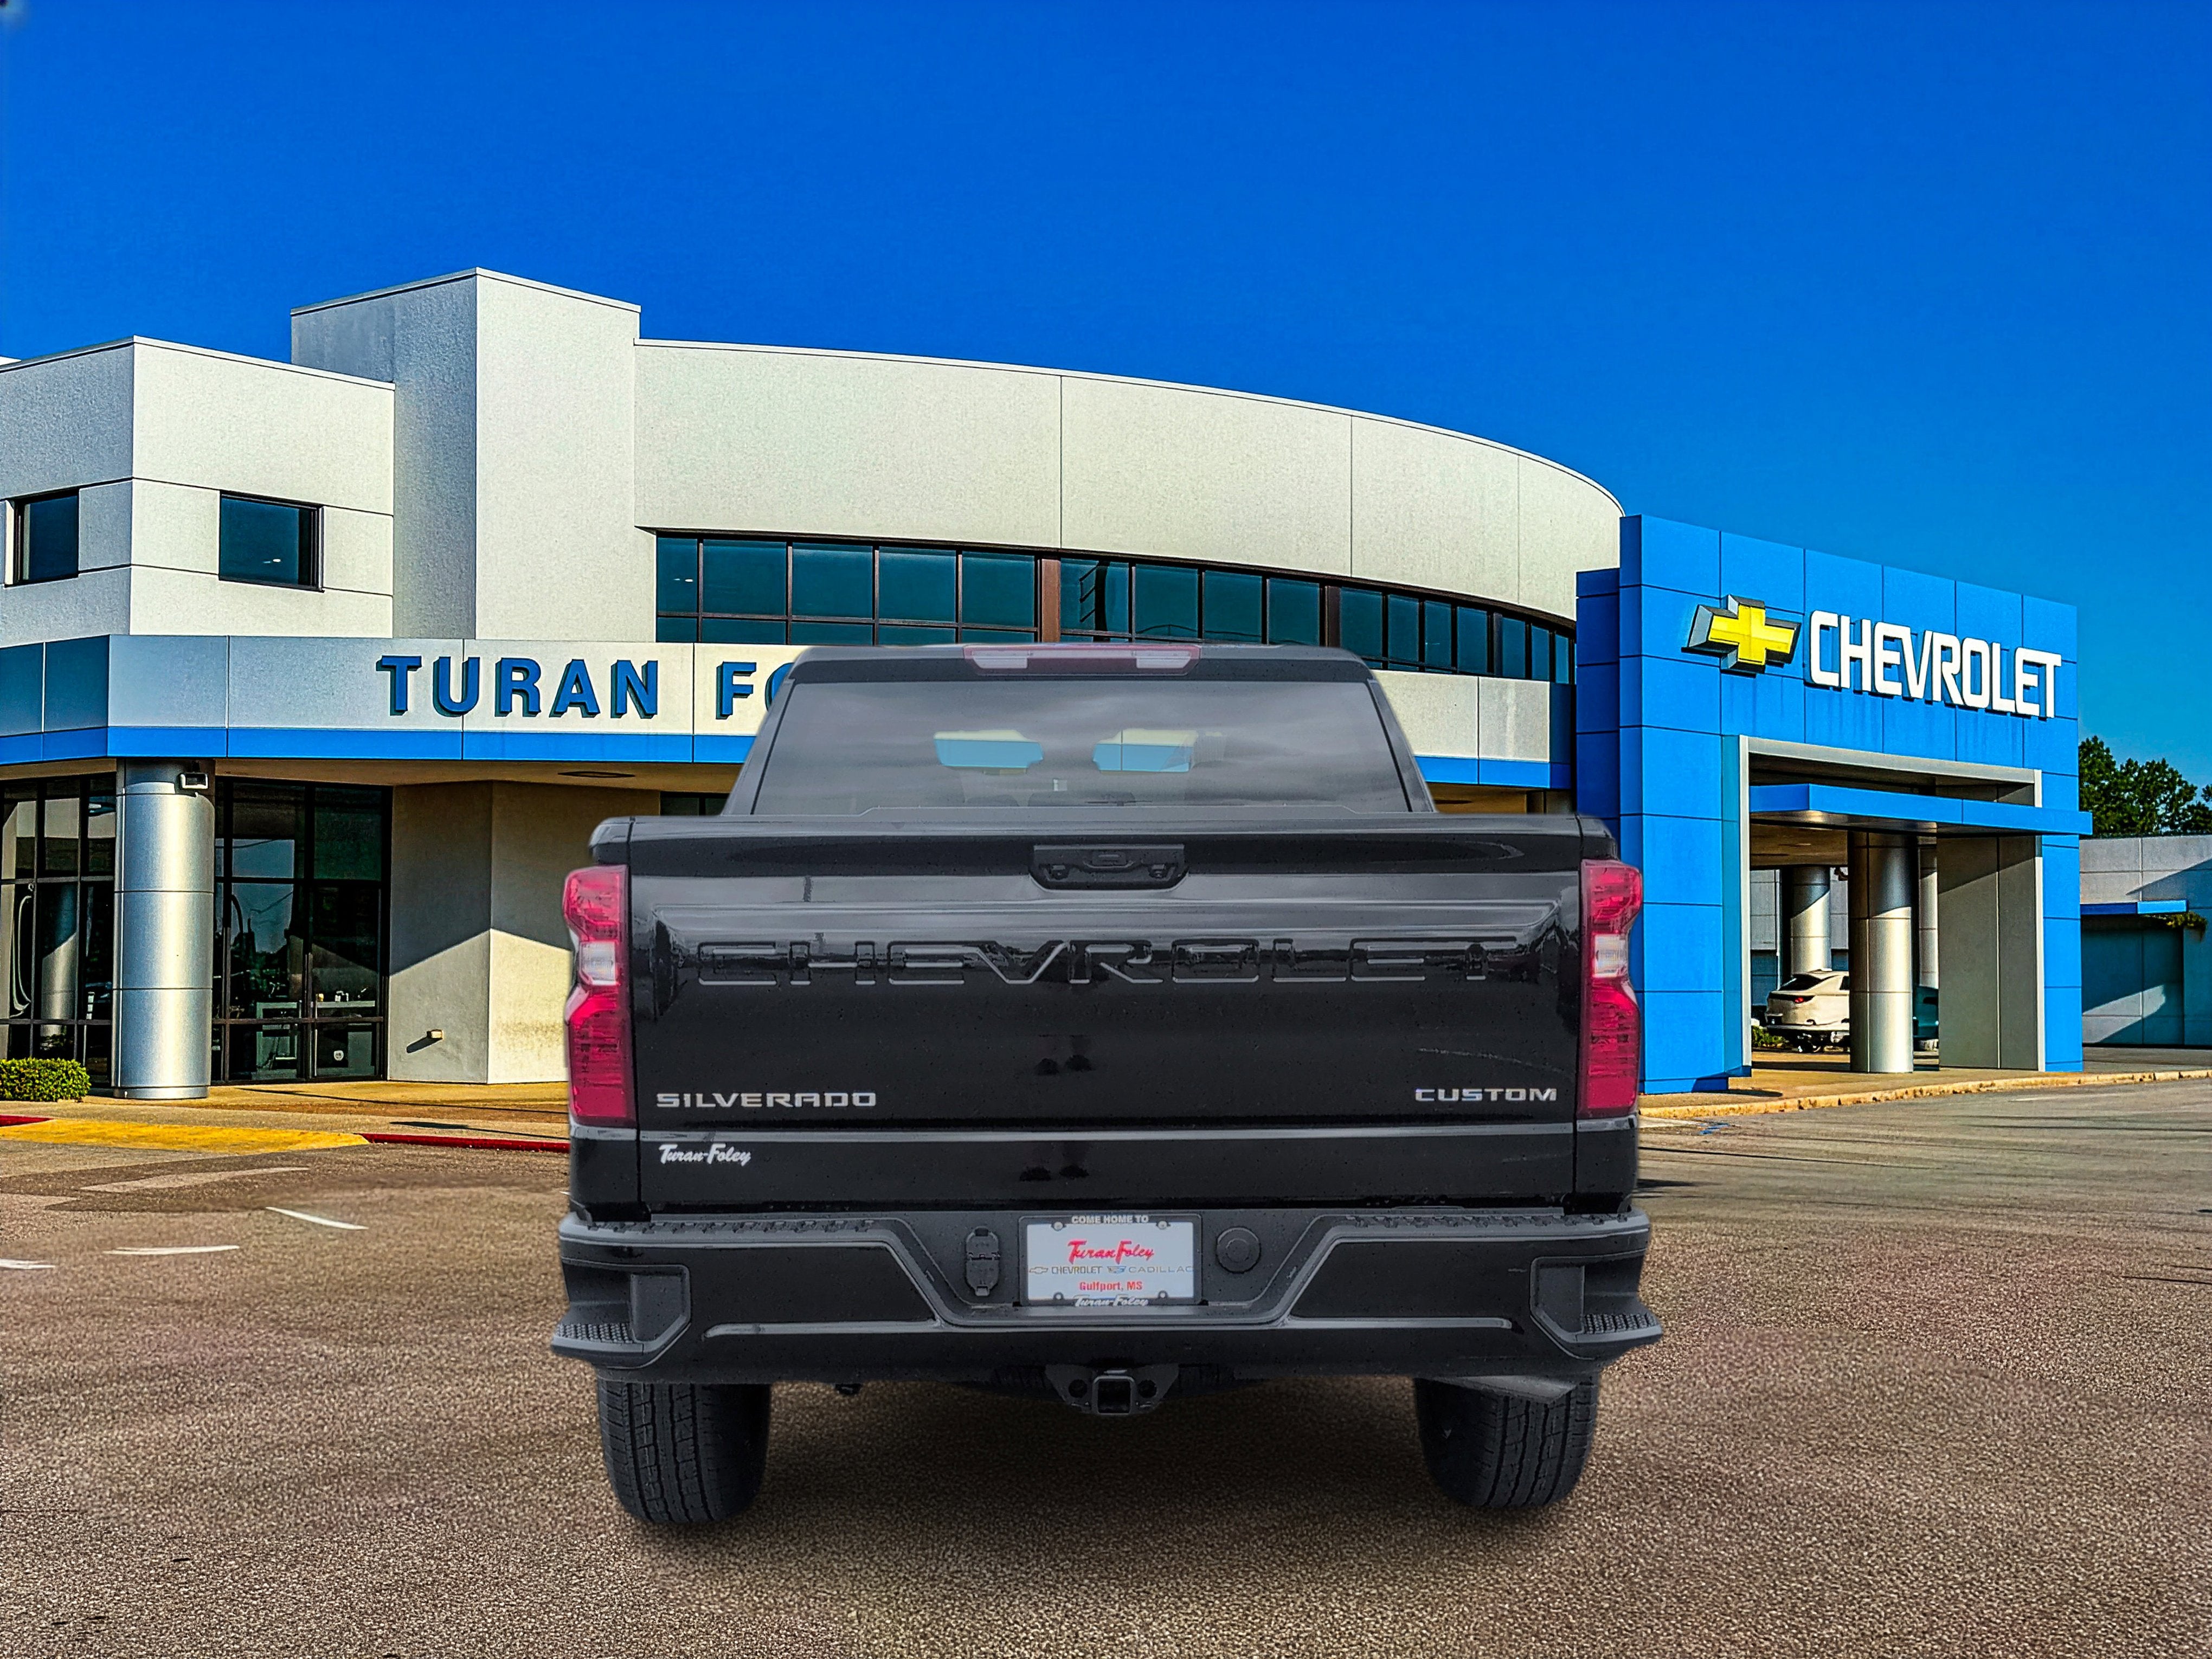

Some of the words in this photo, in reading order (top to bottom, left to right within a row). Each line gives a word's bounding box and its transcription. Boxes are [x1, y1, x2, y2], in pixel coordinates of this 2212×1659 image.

[1809, 610, 2062, 719] CHEVROLET
[376, 655, 658, 720] TURAN
[697, 936, 1518, 986] CHEVROLET
[656, 1092, 877, 1108] SILVERADO
[1414, 1088, 1557, 1102] CUSTOM
[1071, 1215, 1101, 1224] COME
[1103, 1214, 1133, 1223] HOME
[1135, 1214, 1149, 1223] TO
[1051, 1265, 1103, 1275] CHEVROLET
[1079, 1281, 1124, 1292] Gulfport,
[1127, 1281, 1143, 1290] MS
